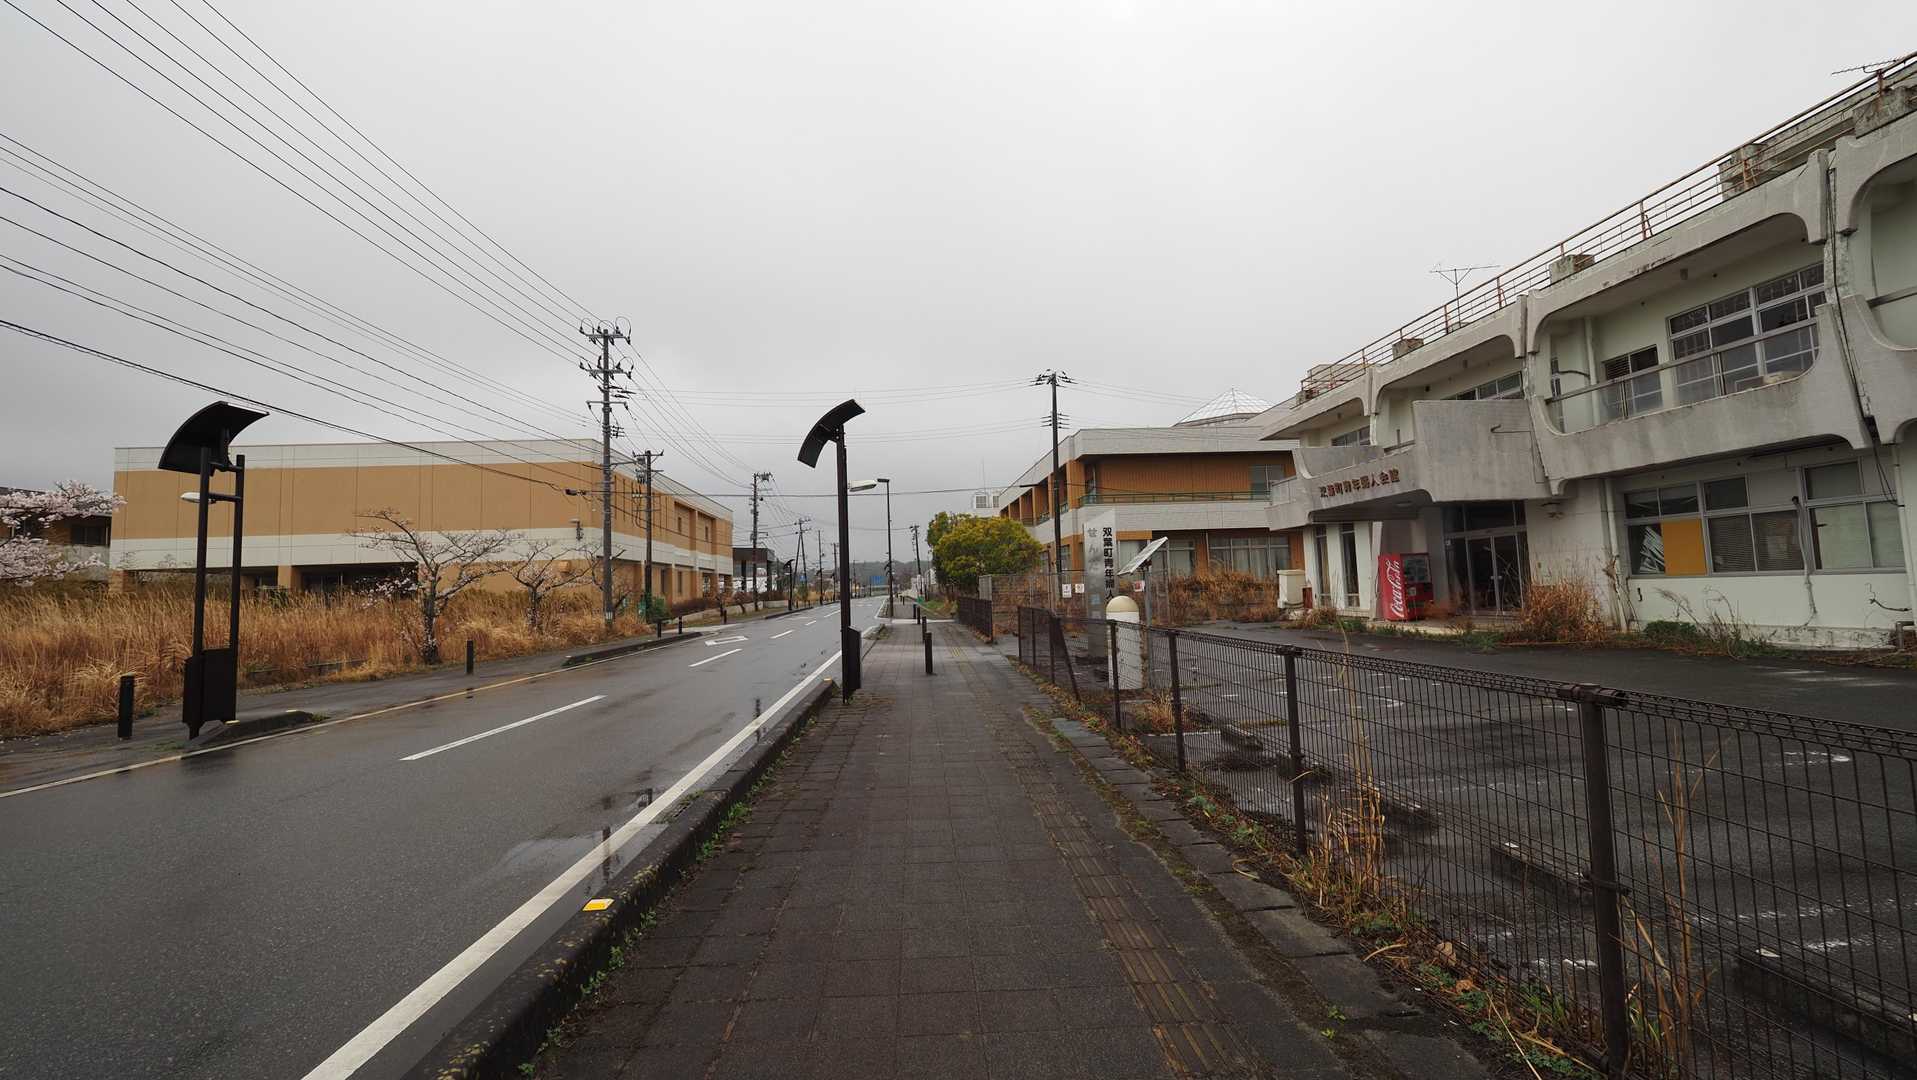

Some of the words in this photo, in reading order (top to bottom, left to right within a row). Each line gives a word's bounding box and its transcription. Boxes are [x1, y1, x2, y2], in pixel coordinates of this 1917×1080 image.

[1102, 527, 1115, 603] 双葉町青年婦人
[1385, 560, 1405, 618] Coca-Cola
